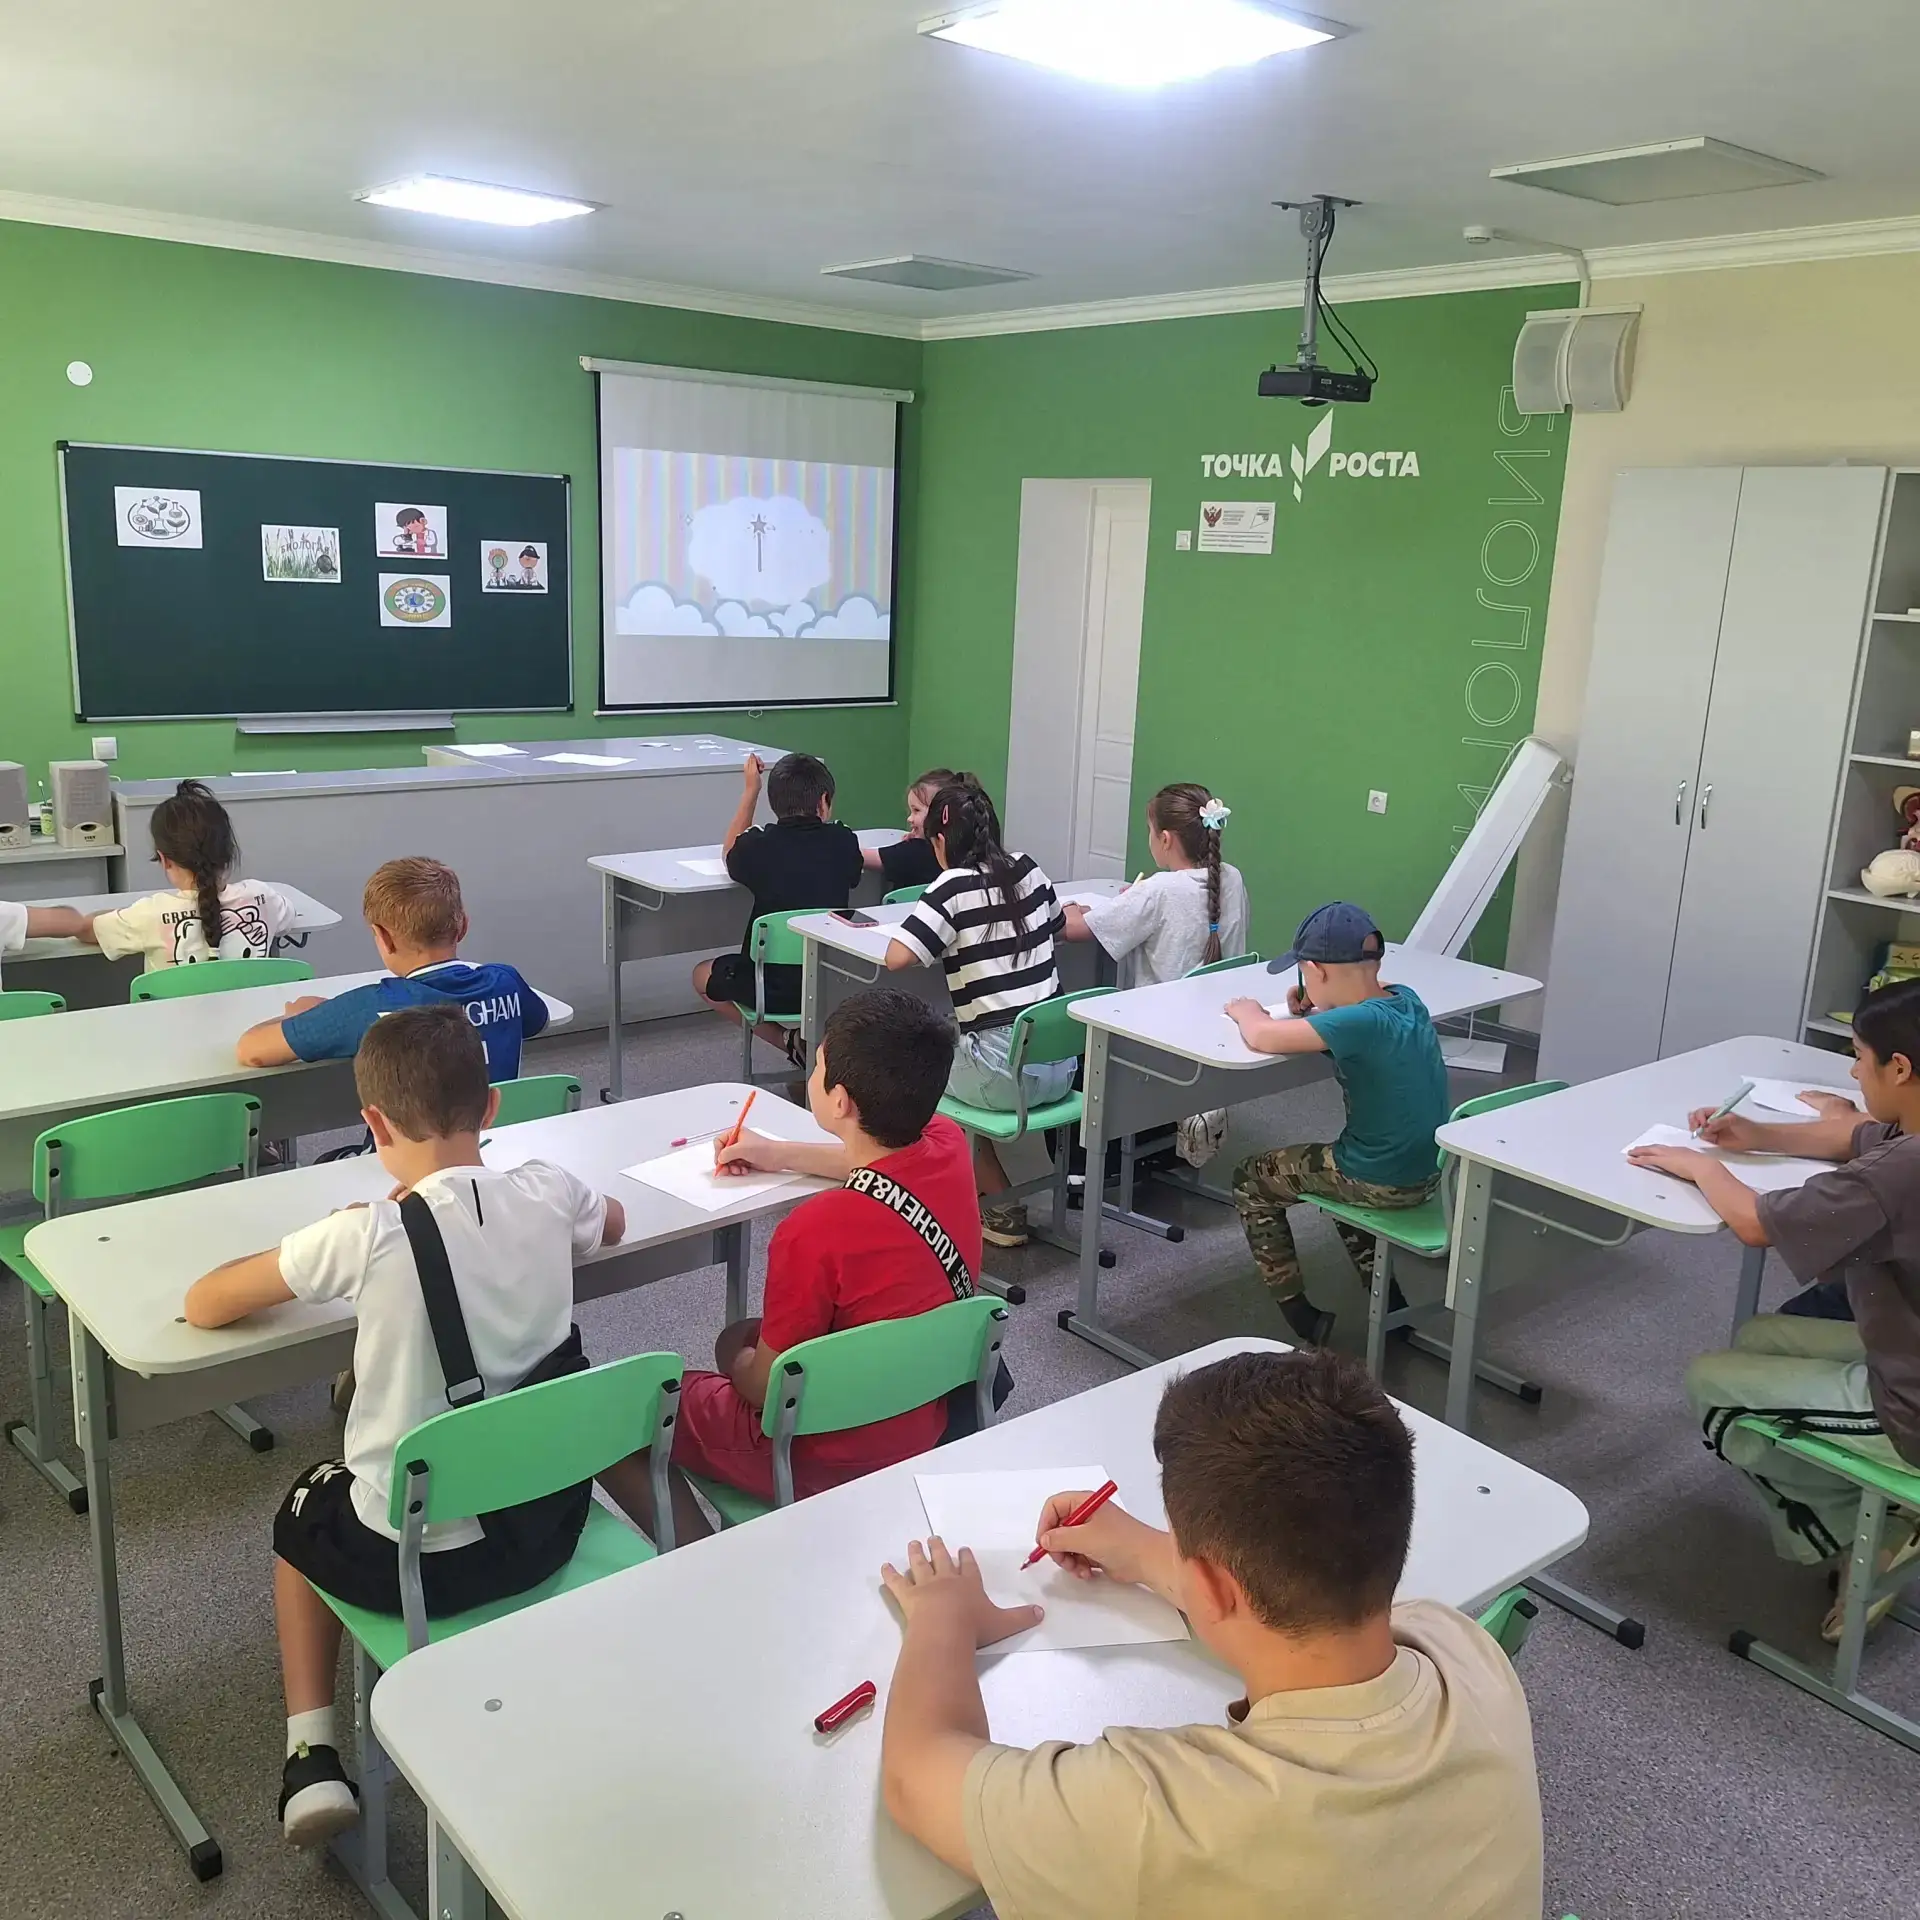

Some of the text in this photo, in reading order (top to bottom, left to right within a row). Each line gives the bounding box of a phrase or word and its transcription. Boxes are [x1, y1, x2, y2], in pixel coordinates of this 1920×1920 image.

[1200, 451, 1421, 479] ТОЧКА РОСТА
[1450, 384, 1555, 898] БИОЛОГ
[462, 992, 521, 1027] GHAM
